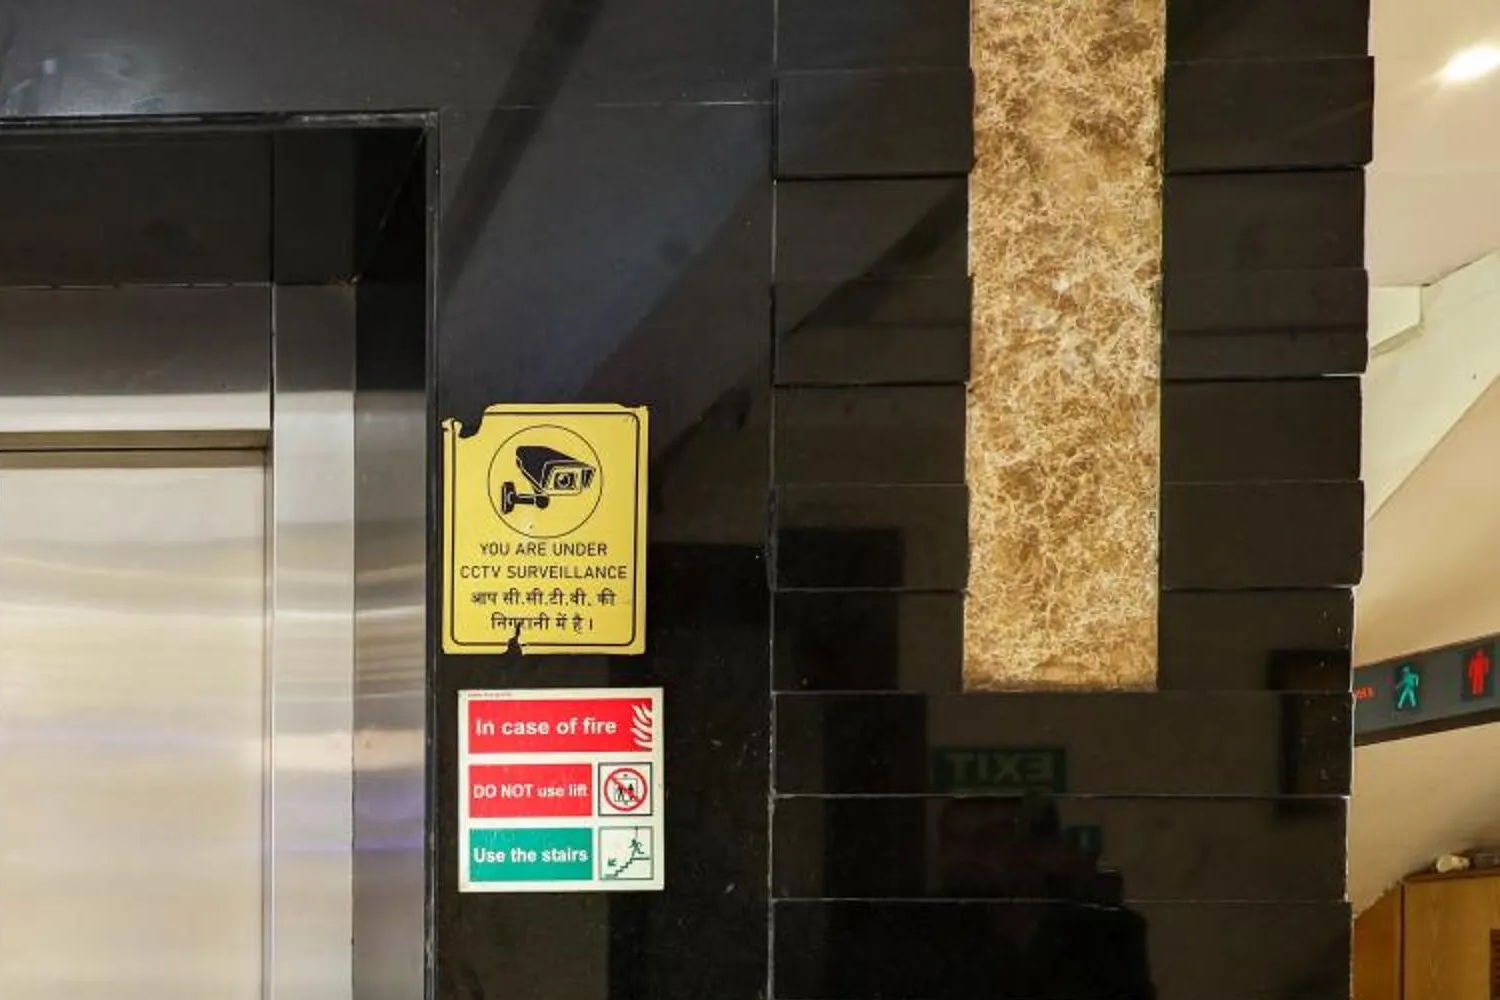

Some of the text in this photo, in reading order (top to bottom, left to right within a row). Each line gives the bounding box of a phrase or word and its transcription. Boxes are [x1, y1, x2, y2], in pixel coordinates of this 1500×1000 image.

[480, 542, 608, 556] YOU ARE UNDER
[460, 566, 628, 579] CCTV SURVEILLANCE
[471, 591, 497, 606] आप
[597, 587, 617, 606] की
[556, 612, 571, 630] में
[476, 717, 617, 736] In case of fire
[473, 782, 589, 799] DO NOT use lift
[474, 847, 589, 863] Use the stairs
